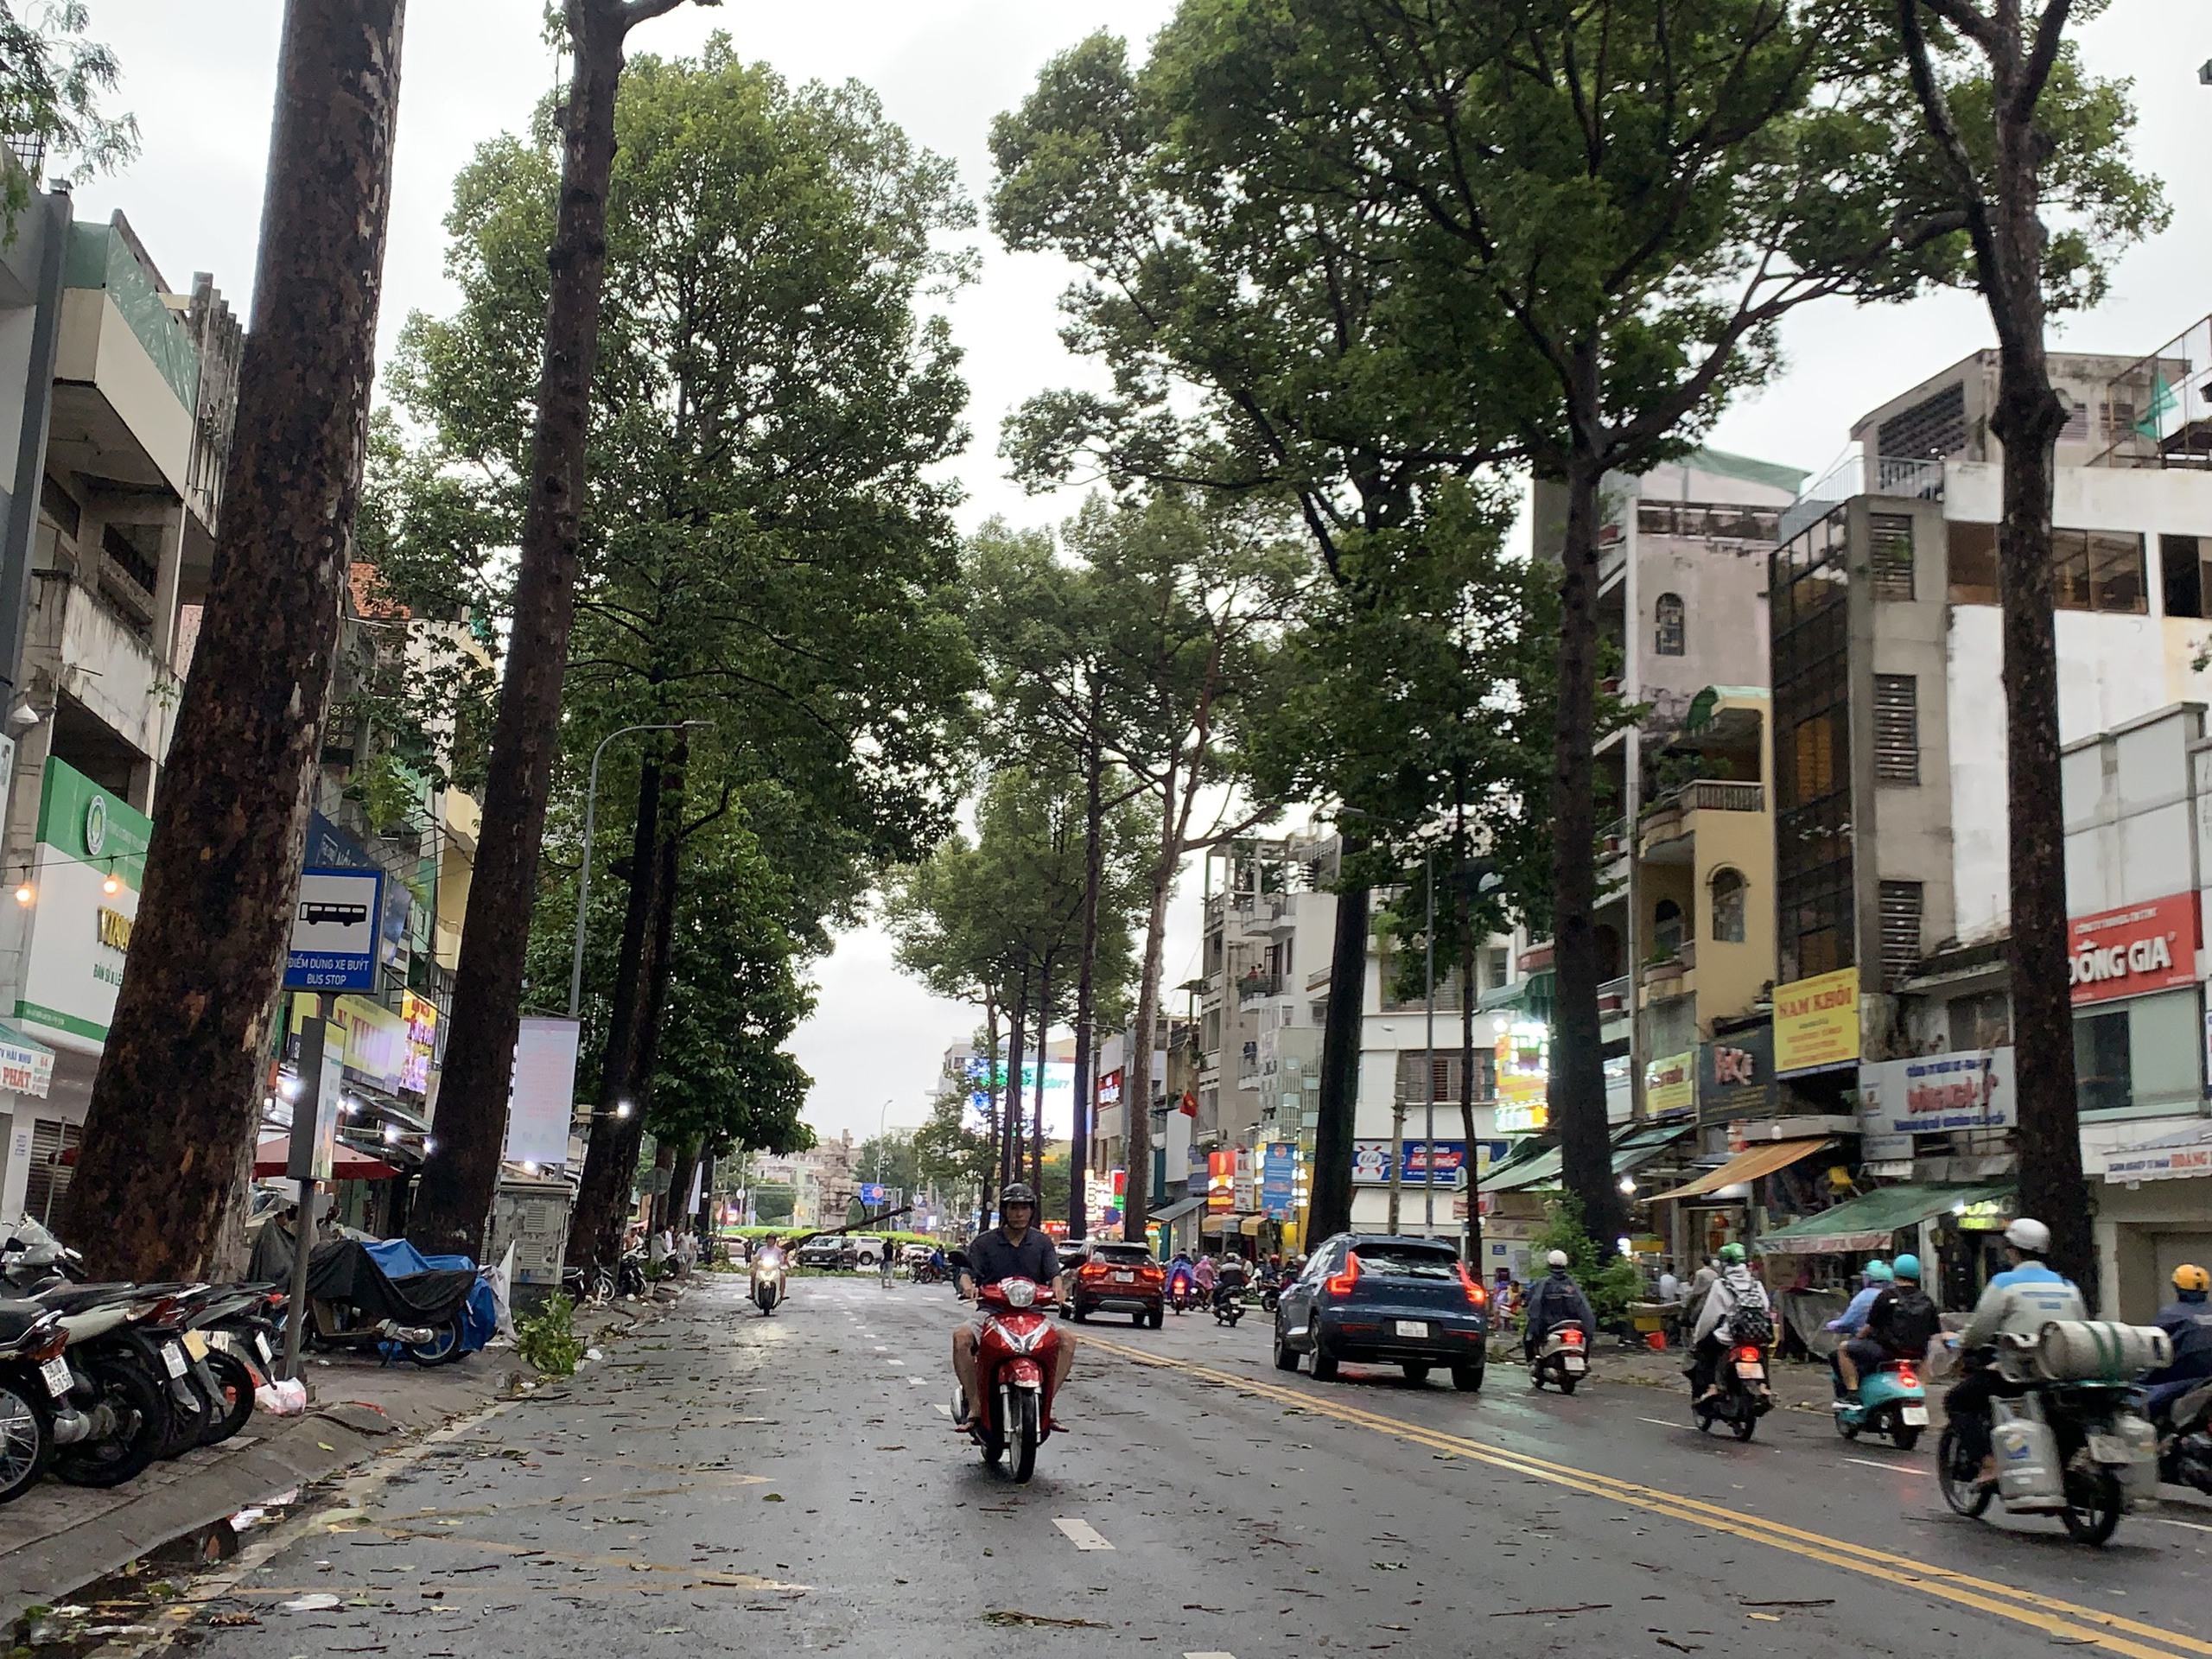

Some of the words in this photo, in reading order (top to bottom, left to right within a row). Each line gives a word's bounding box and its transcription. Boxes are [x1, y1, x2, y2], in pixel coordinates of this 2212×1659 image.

[334, 959, 346, 970] XE
[347, 957, 370, 971] BUÝT
[2128, 936, 2172, 973] GIA
[306, 973, 324, 985] BUS
[325, 975, 347, 986] STOP
[3, 1065, 32, 1089] PHÁT
